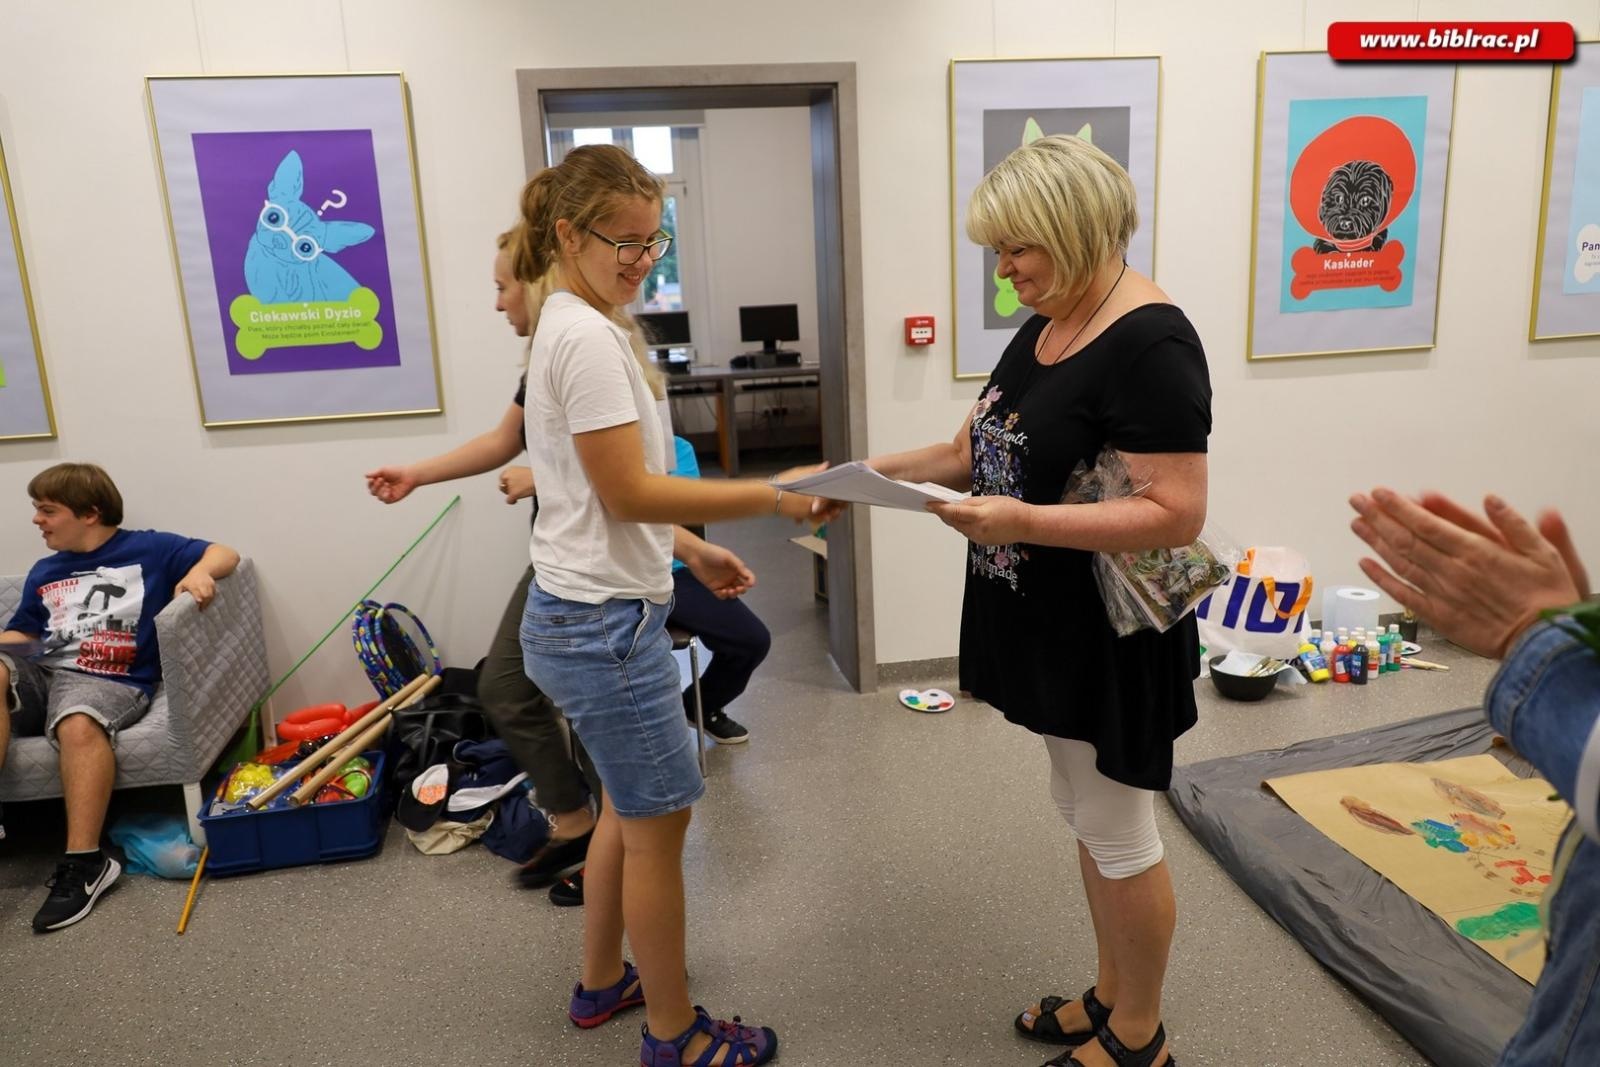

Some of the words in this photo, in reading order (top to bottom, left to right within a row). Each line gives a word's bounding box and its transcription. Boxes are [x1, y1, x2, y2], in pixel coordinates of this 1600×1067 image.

[1324, 258, 1375, 270] Kaskader
[249, 308, 320, 323] Ciekawski
[324, 307, 362, 321] Dyzio
